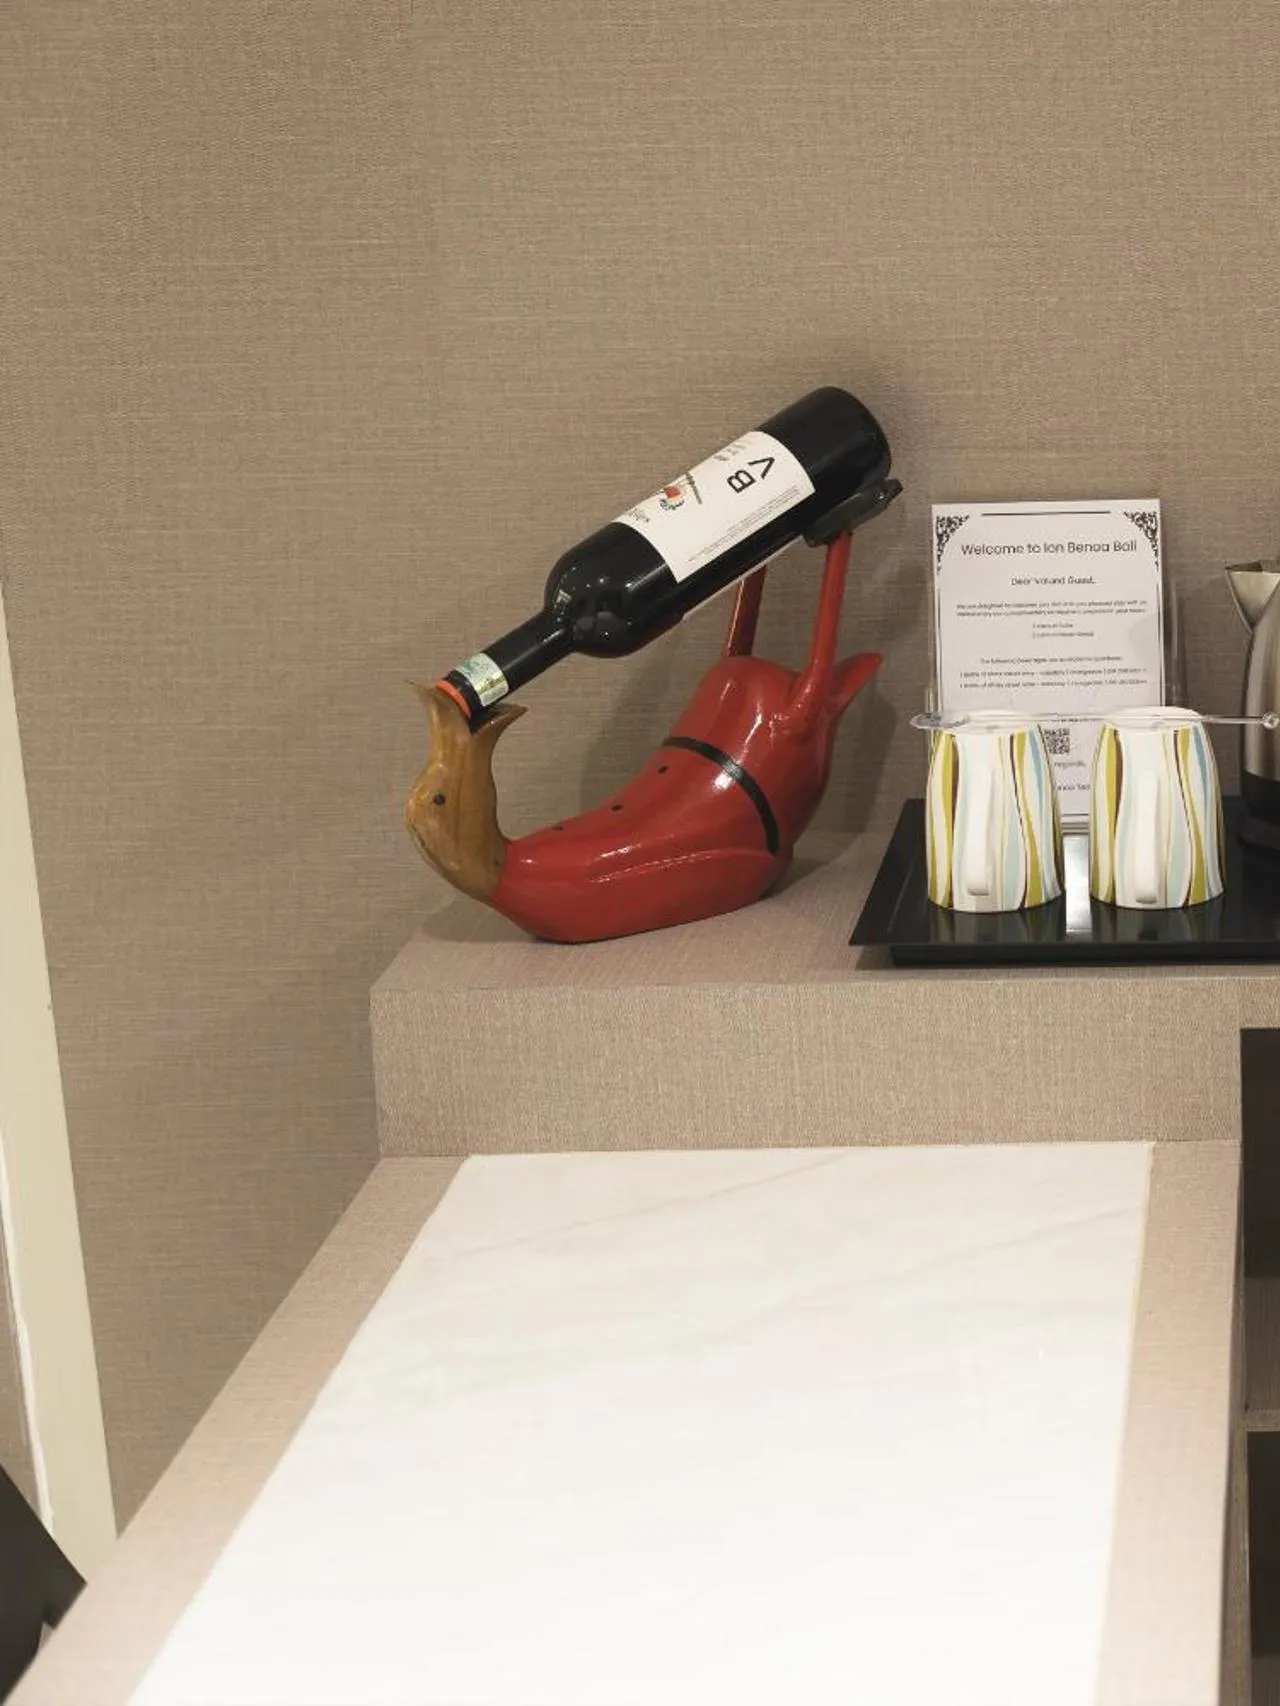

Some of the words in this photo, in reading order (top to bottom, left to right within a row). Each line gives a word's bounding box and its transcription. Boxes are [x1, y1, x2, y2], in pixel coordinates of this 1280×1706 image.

[961, 543, 1023, 556] Welcome
[1027, 543, 1041, 553] to
[1067, 541, 1110, 553] Benoa
[1113, 540, 1137, 552] Bali
[1011, 577, 1031, 586] Dear
